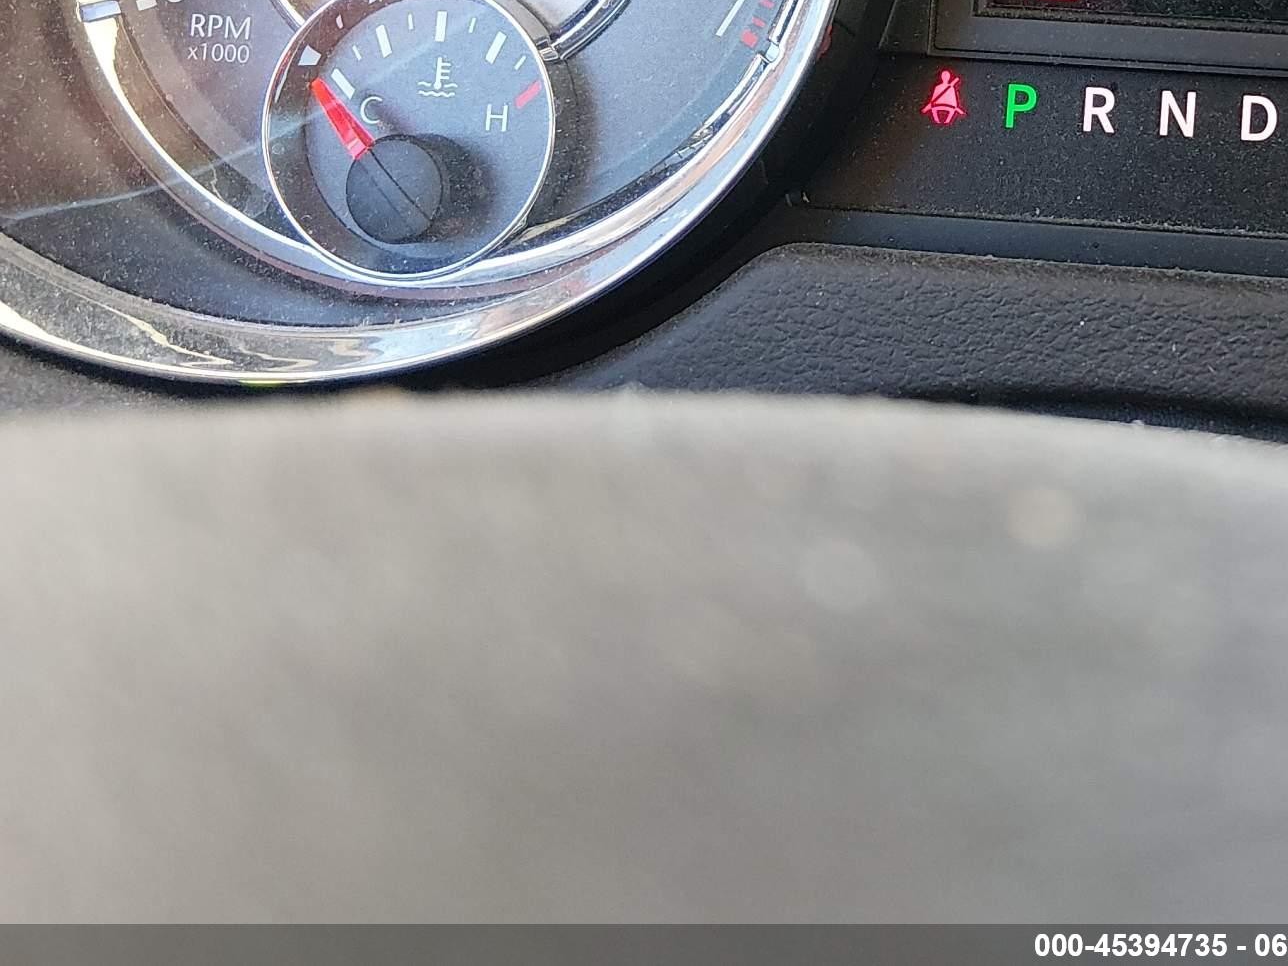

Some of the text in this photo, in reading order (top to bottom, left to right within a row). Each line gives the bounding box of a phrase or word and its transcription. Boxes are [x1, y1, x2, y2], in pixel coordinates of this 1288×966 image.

[191, 13, 252, 41] RPM
[188, 42, 251, 65] x1000
[359, 96, 384, 124] C
[486, 104, 510, 132] H
[1005, 84, 1277, 142] P R N D
